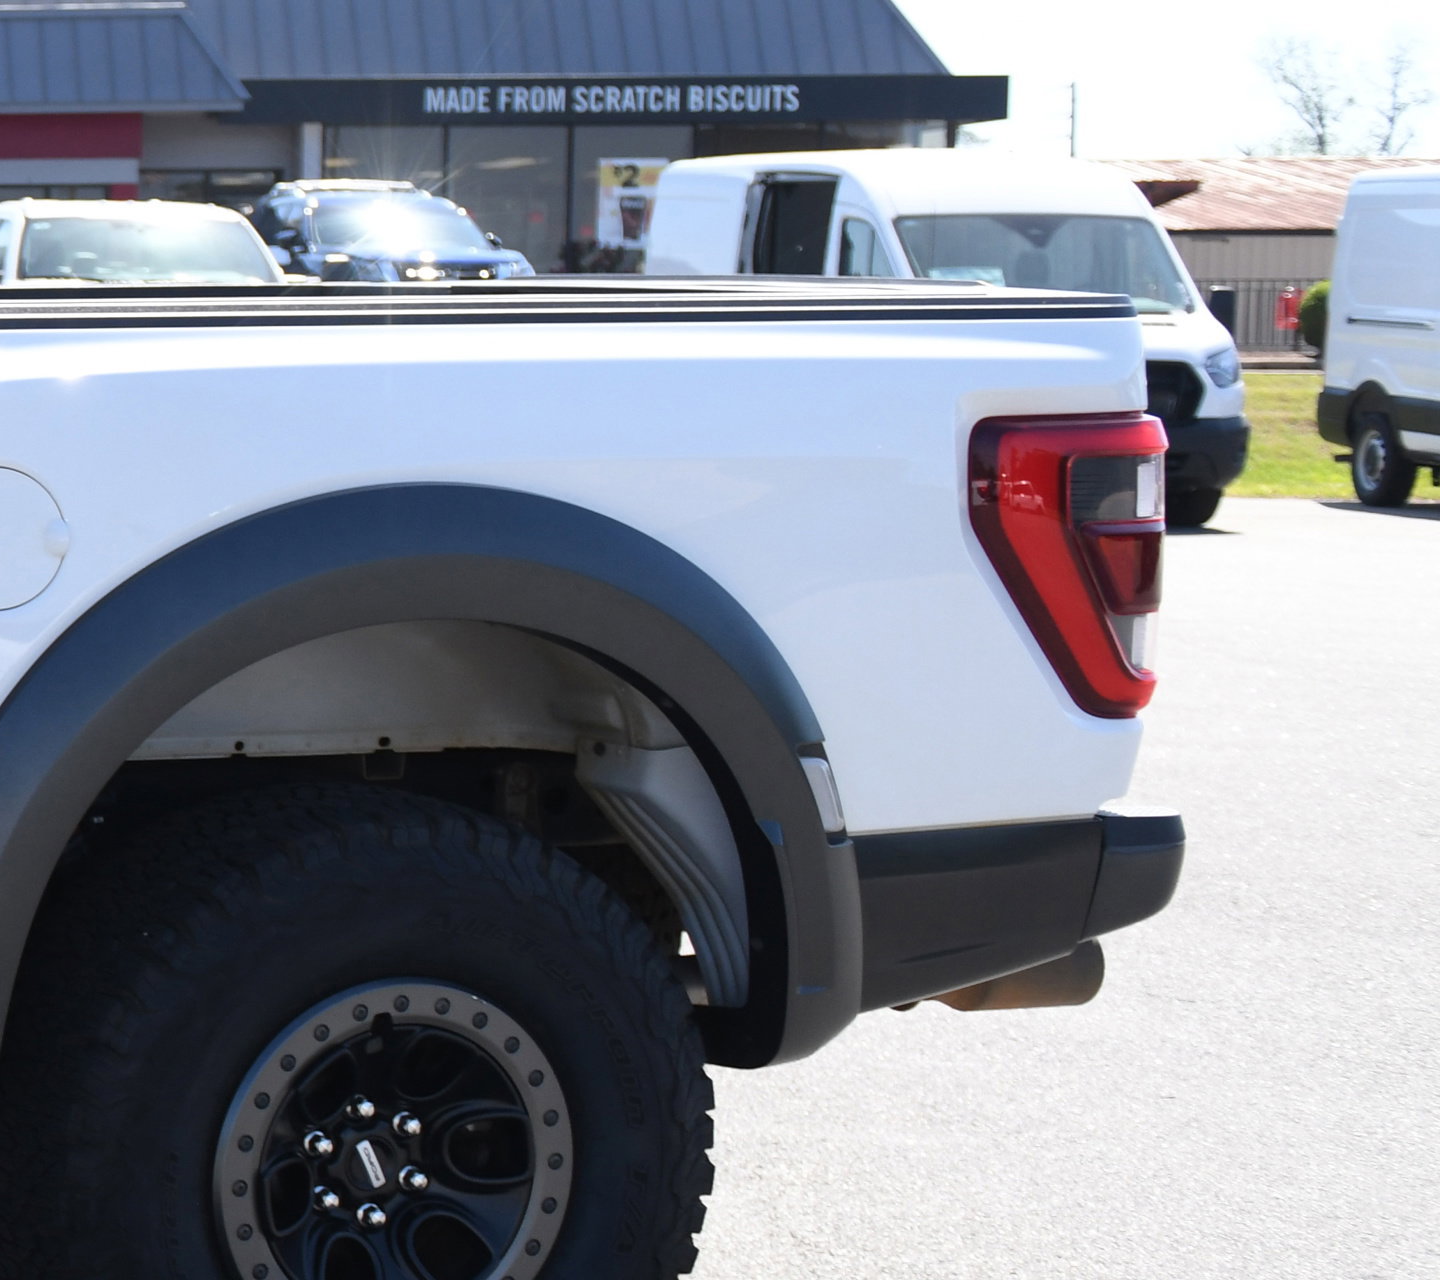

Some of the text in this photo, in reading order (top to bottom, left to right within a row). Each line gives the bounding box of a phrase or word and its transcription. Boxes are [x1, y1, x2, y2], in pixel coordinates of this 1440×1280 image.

[424, 84, 801, 113] MADE FROM SCRATCH BISCUITS
